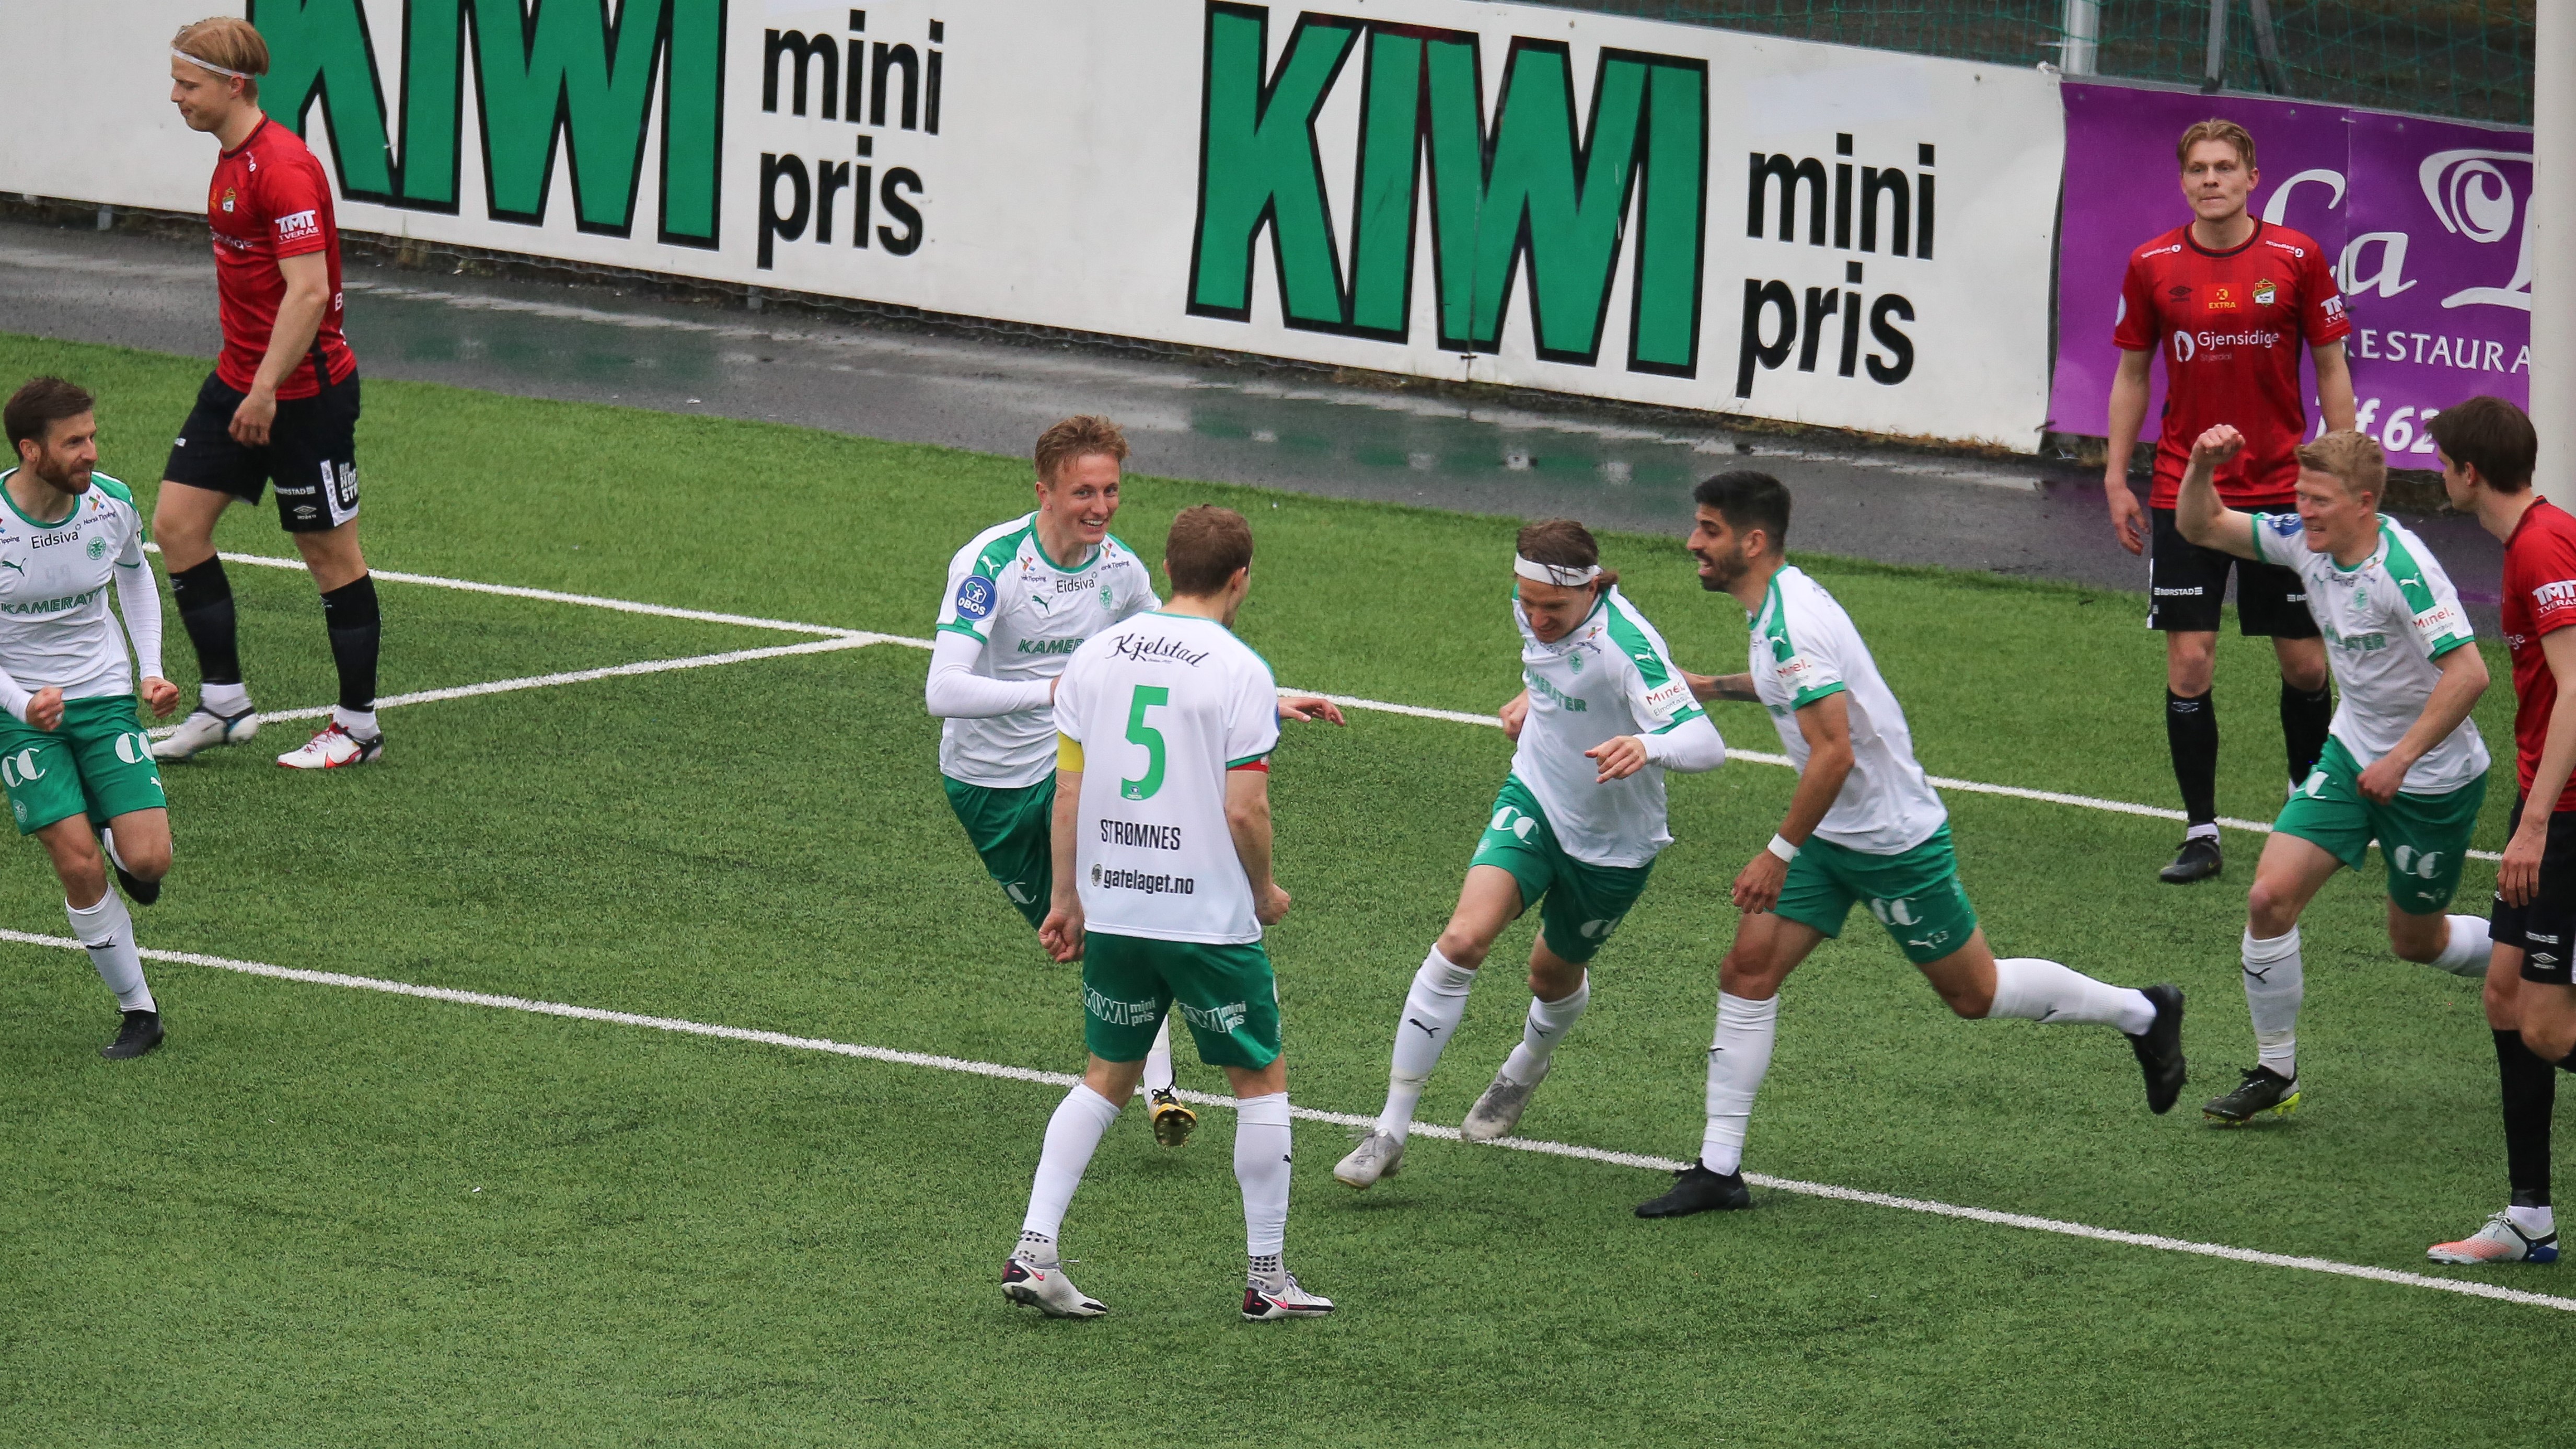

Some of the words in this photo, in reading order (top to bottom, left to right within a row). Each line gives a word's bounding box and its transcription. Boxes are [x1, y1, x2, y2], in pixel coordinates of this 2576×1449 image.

[761, 9, 944, 136] mini
[246, 0, 729, 250] KIWI
[756, 134, 925, 270] pris
[1186, 1, 1709, 380] KIWI
[1747, 133, 1936, 260] mini
[1735, 261, 1915, 399] pris
[2198, 330, 2279, 351] Gjensidige
[32, 530, 79, 549] Eidsiva
[1057, 578, 1095, 593] Eidsiva
[958, 597, 986, 615] OBOS
[2412, 607, 2455, 630] Minel.
[1105, 632, 1210, 668] Kjelstad
[1121, 684, 1169, 801] 5
[1100, 819, 1181, 850] STRØMNES
[1103, 869, 1195, 895] gatelaget.no
[1129, 997, 1156, 1013] mini
[1131, 1011, 1154, 1027] pris
